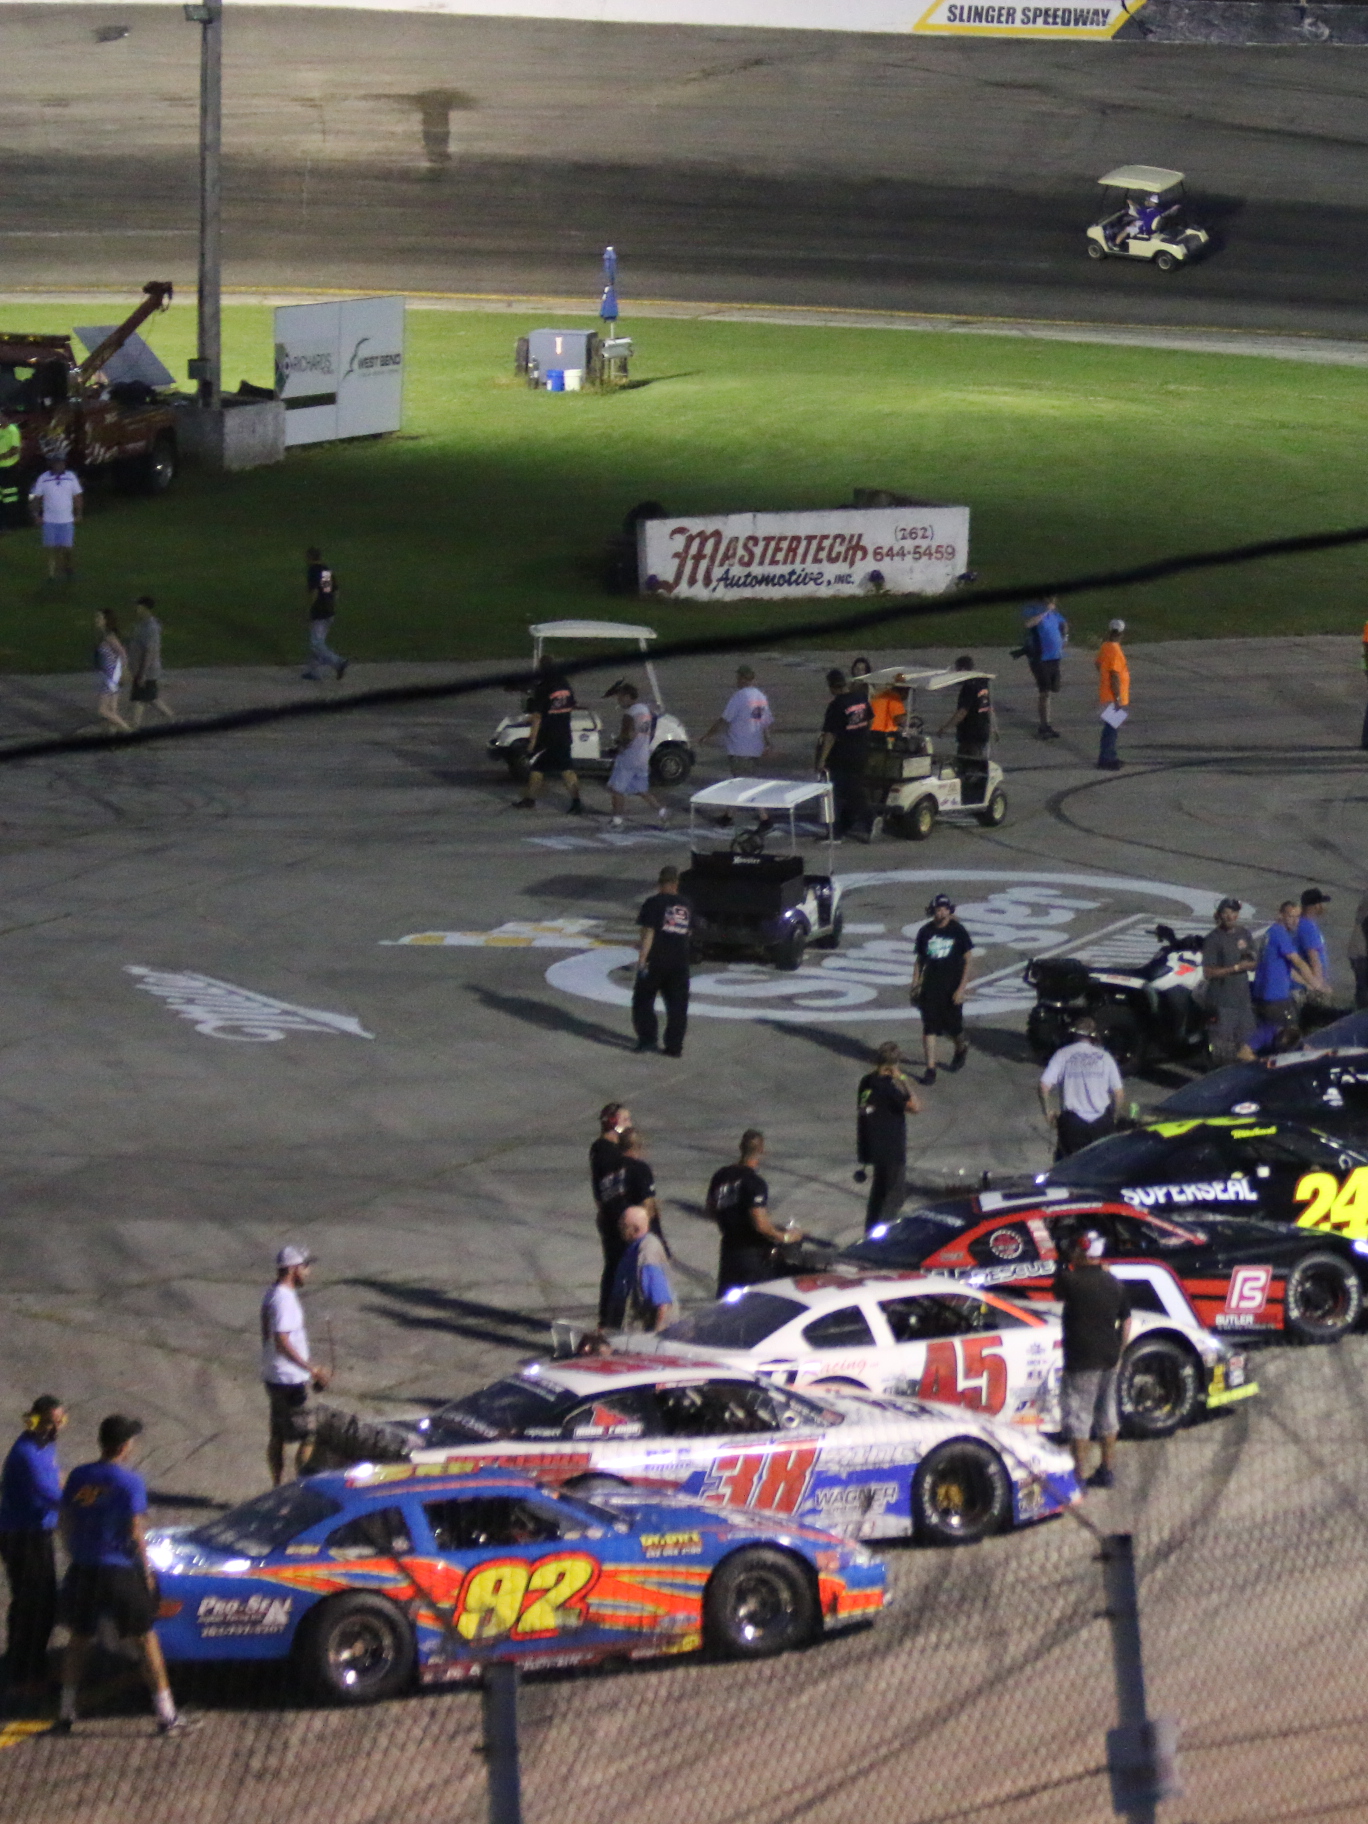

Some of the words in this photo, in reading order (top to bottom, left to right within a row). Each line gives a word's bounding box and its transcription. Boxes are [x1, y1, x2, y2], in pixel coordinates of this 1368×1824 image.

[946, 4, 1016, 25] SLINGER
[1020, 6, 1111, 27] SPEEDWAY
[894, 524, 935, 542] (262)
[1120, 1177, 1258, 1206] SUPERSEAL
[1215, 1313, 1254, 1326] BUTLER
[918, 1335, 1008, 1416] 45
[815, 1482, 898, 1513] WAGNER
[456, 1553, 601, 1642] 92
